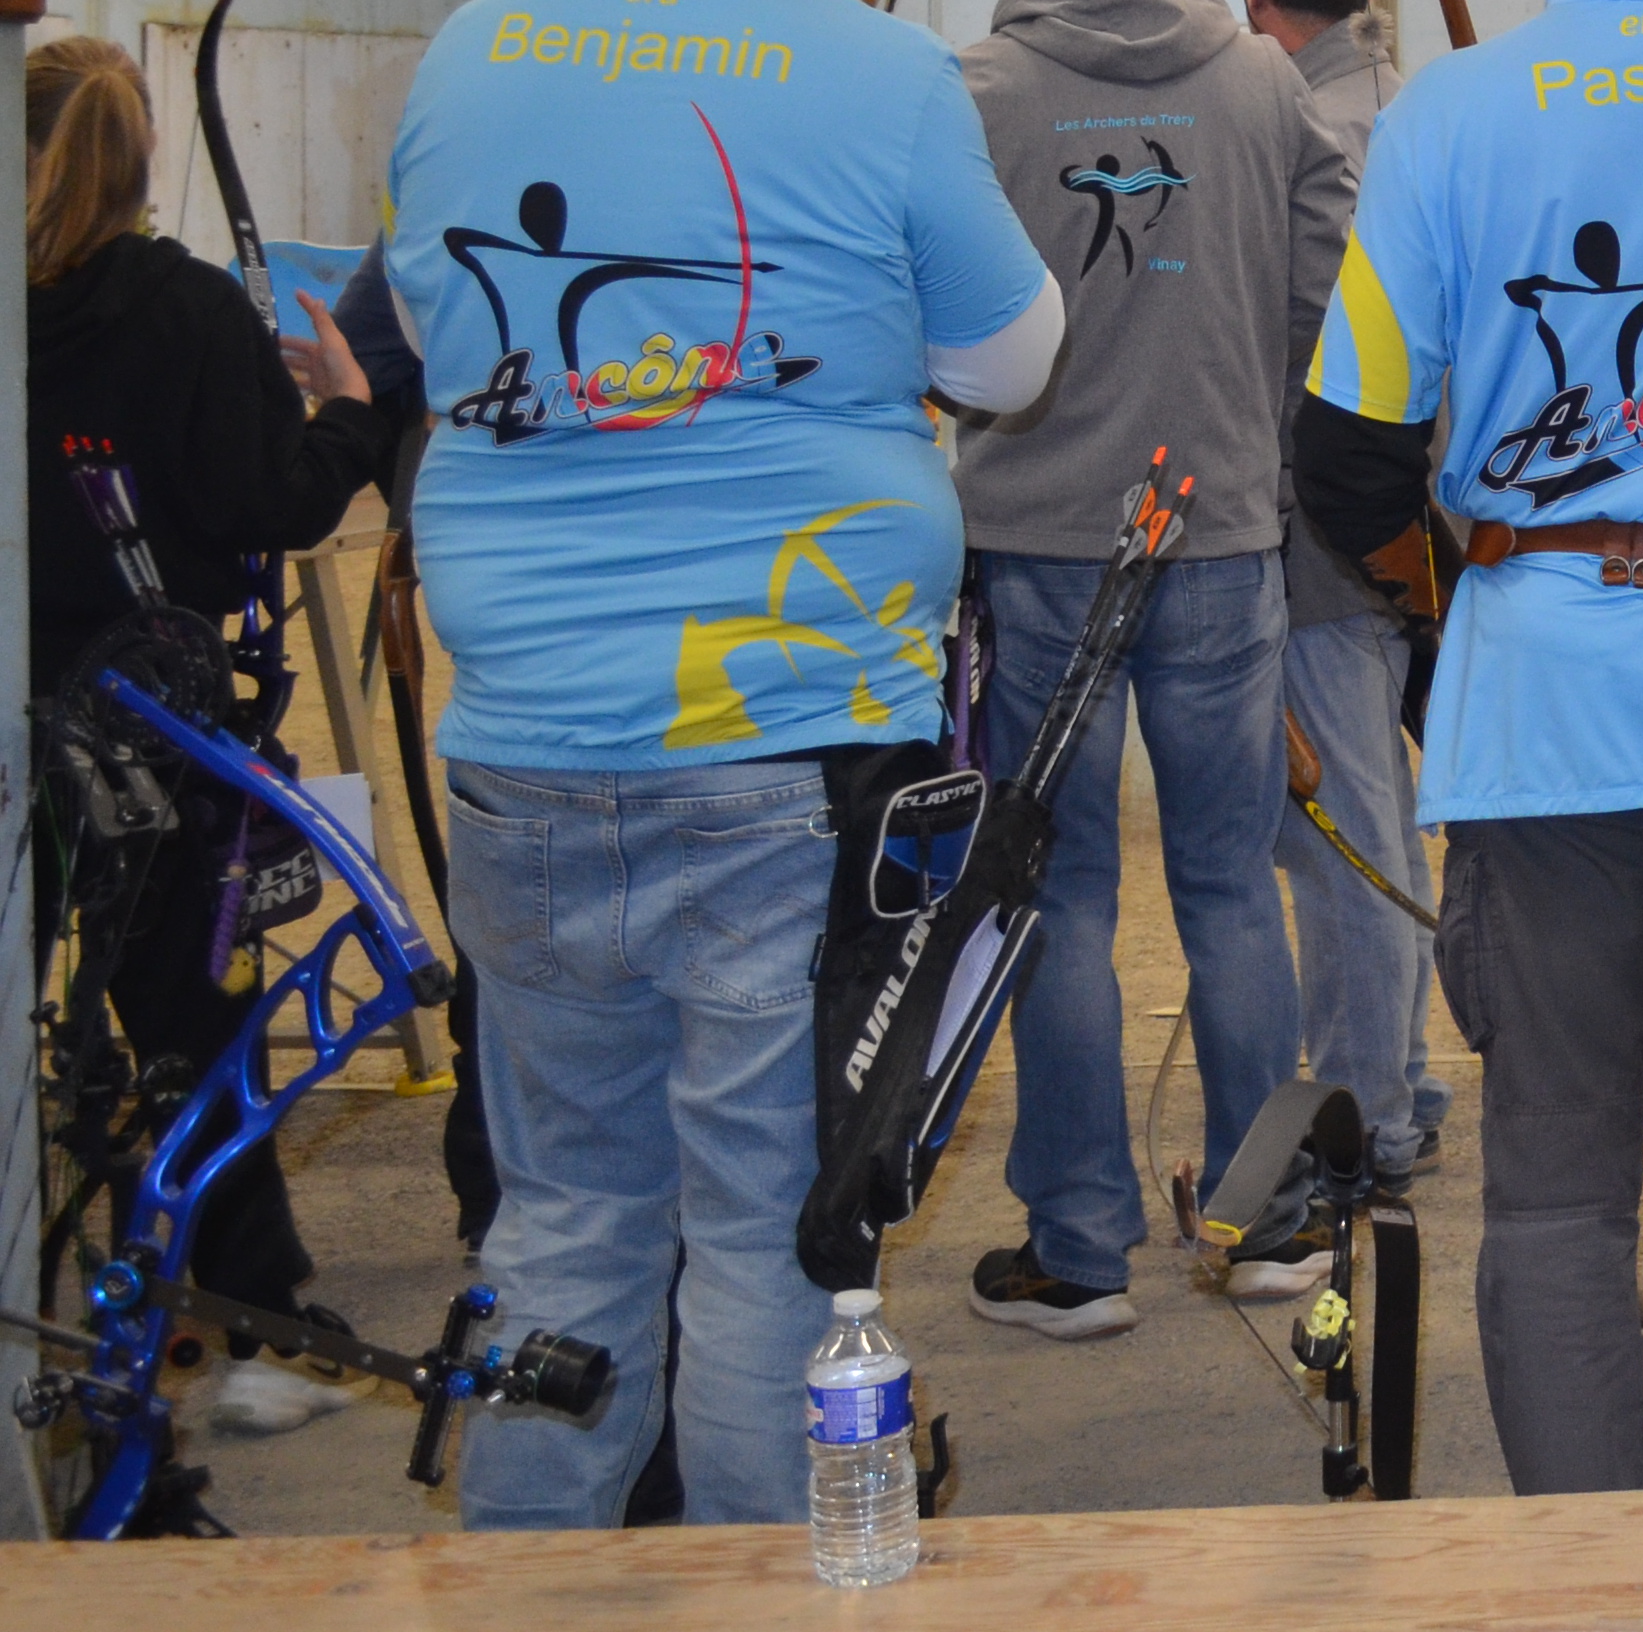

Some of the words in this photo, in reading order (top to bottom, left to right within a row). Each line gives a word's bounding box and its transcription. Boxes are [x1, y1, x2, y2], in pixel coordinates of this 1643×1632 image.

[488, 12, 794, 83] Benjamin
[1083, 115, 1137, 129] Archers
[1140, 114, 1156, 126] du
[451, 332, 822, 442] Ancône
[895, 779, 984, 810] CLASSIC
[846, 904, 938, 1095] AVALON
